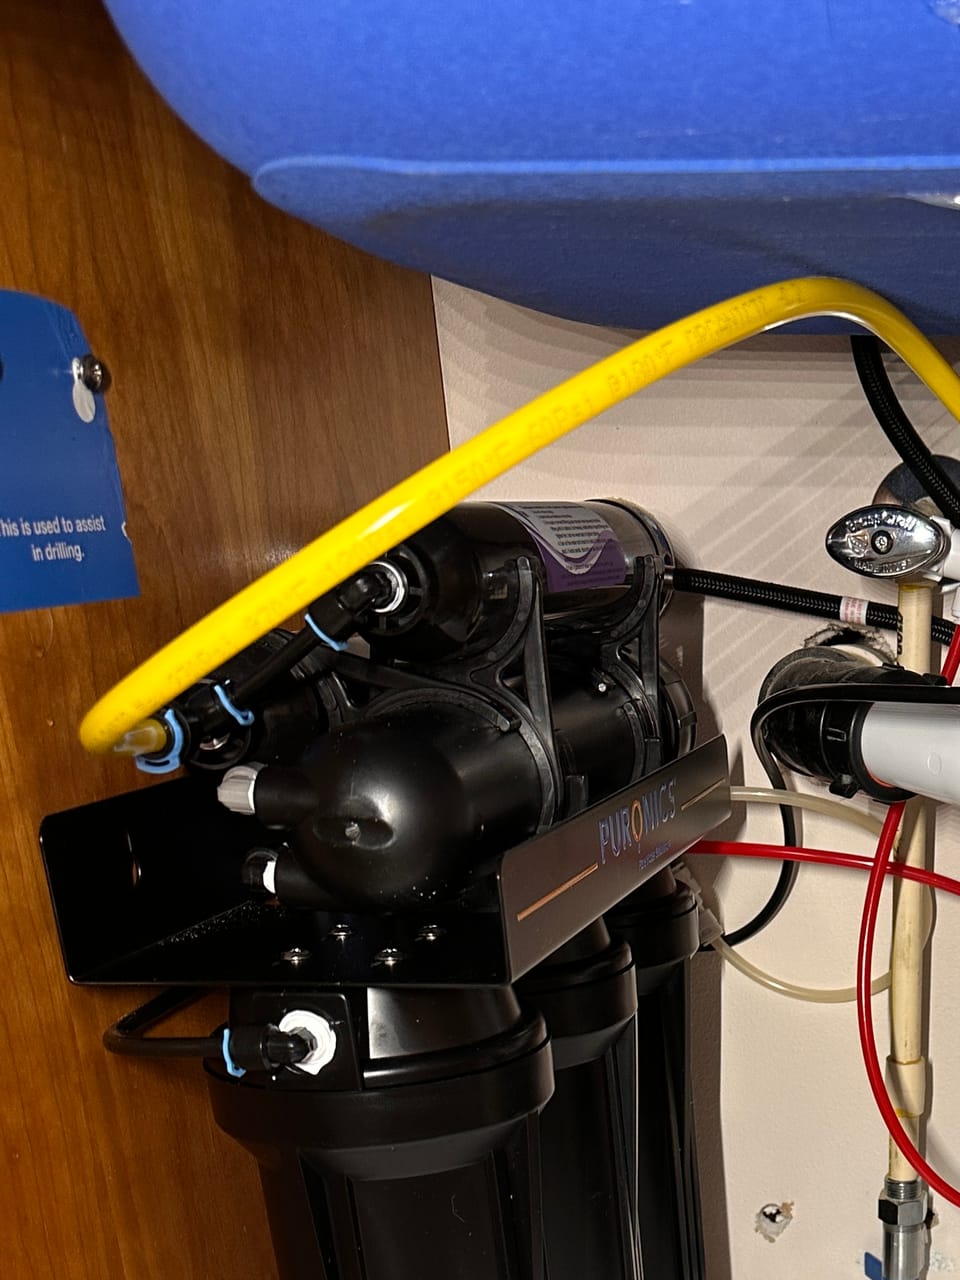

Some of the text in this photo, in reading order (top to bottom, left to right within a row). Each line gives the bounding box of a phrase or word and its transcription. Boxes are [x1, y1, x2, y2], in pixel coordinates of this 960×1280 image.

[20, 516, 32, 536] is
[33, 515, 60, 535] used
[61, 515, 73, 533] to
[75, 514, 106, 532] assist
[31, 541, 85, 562] in drilling.
